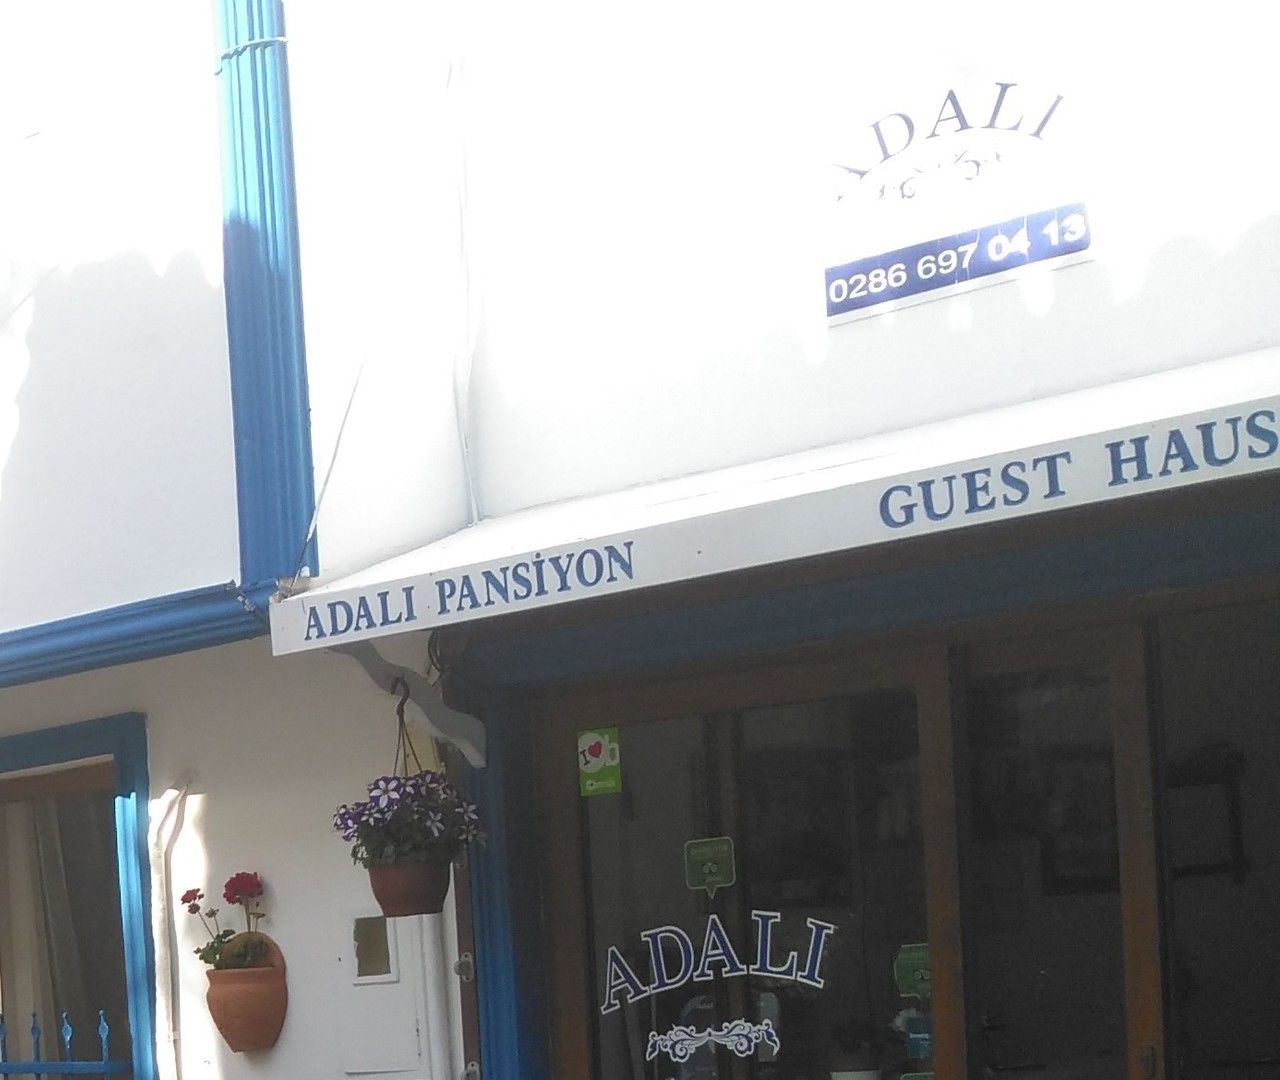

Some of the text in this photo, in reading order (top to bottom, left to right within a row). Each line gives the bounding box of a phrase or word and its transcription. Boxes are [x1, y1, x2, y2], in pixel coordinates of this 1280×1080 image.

[828, 213, 1087, 304] 0286 697 04 13
[303, 409, 1280, 641] ADALI PANSİYON GUEST HAUS
[600, 909, 836, 1016] ADALI
